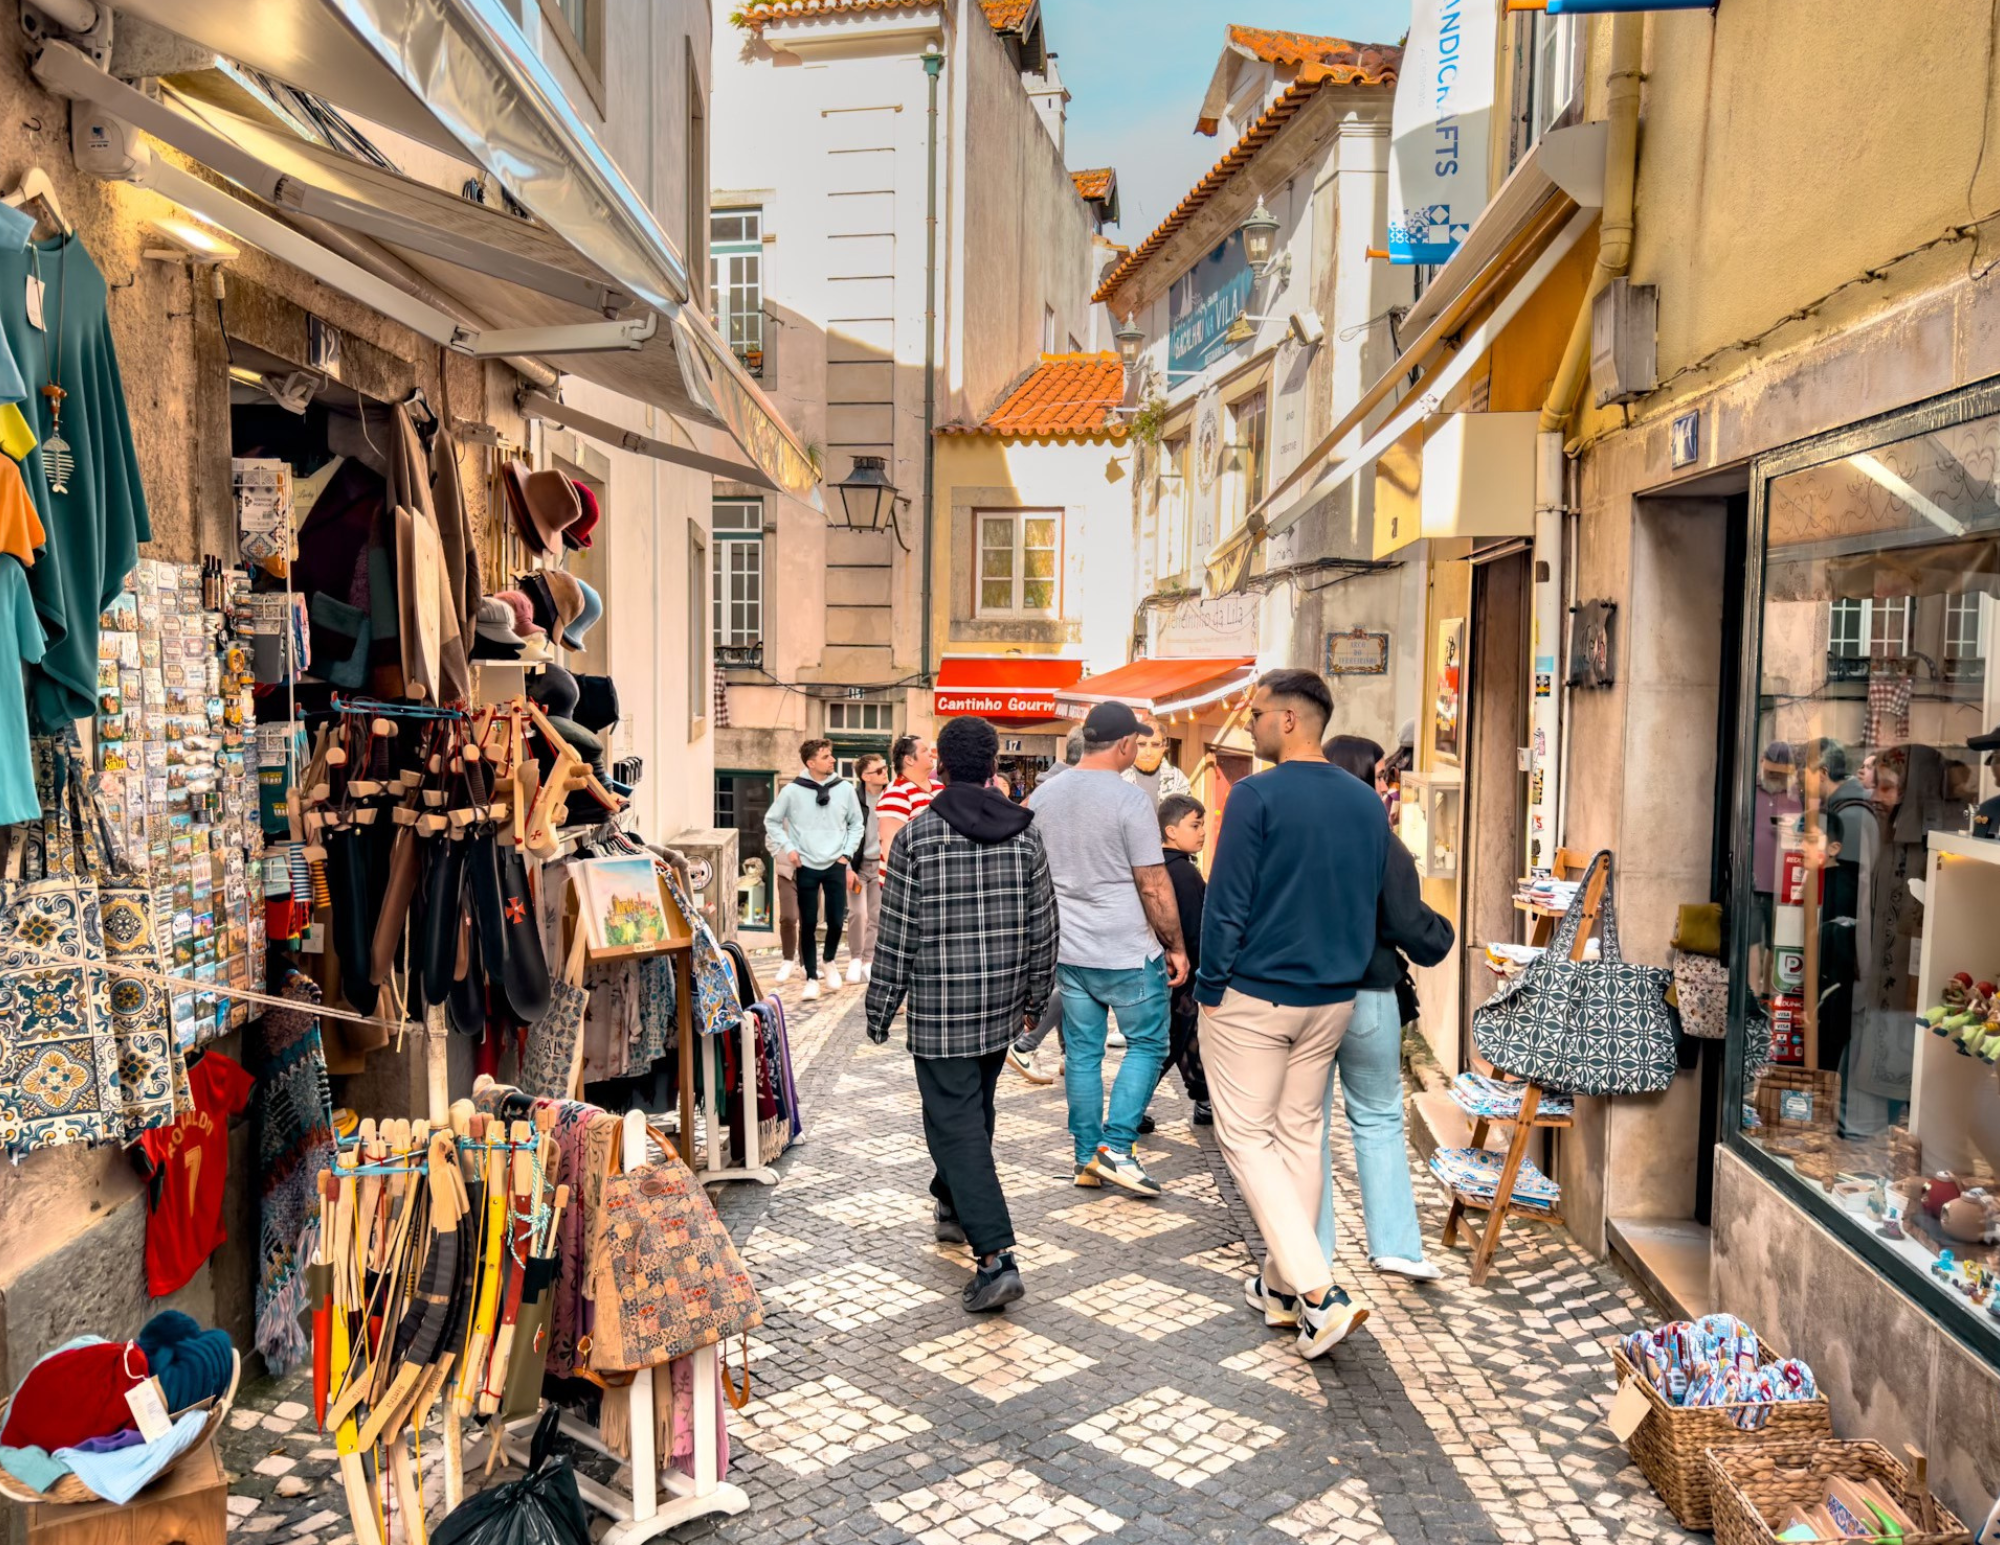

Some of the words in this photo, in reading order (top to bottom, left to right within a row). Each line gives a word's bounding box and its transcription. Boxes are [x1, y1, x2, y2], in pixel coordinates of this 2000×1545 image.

[1434, 0, 1461, 177] ANDICRAFTS
[1215, 288, 1239, 331] VILA
[937, 696, 1003, 712] Cantinho
[1007, 696, 1055, 712] Gourm
[1008, 740, 1018, 751] 17
[184, 1145, 202, 1218] 7
[386, 1385, 405, 1408] Sintra
